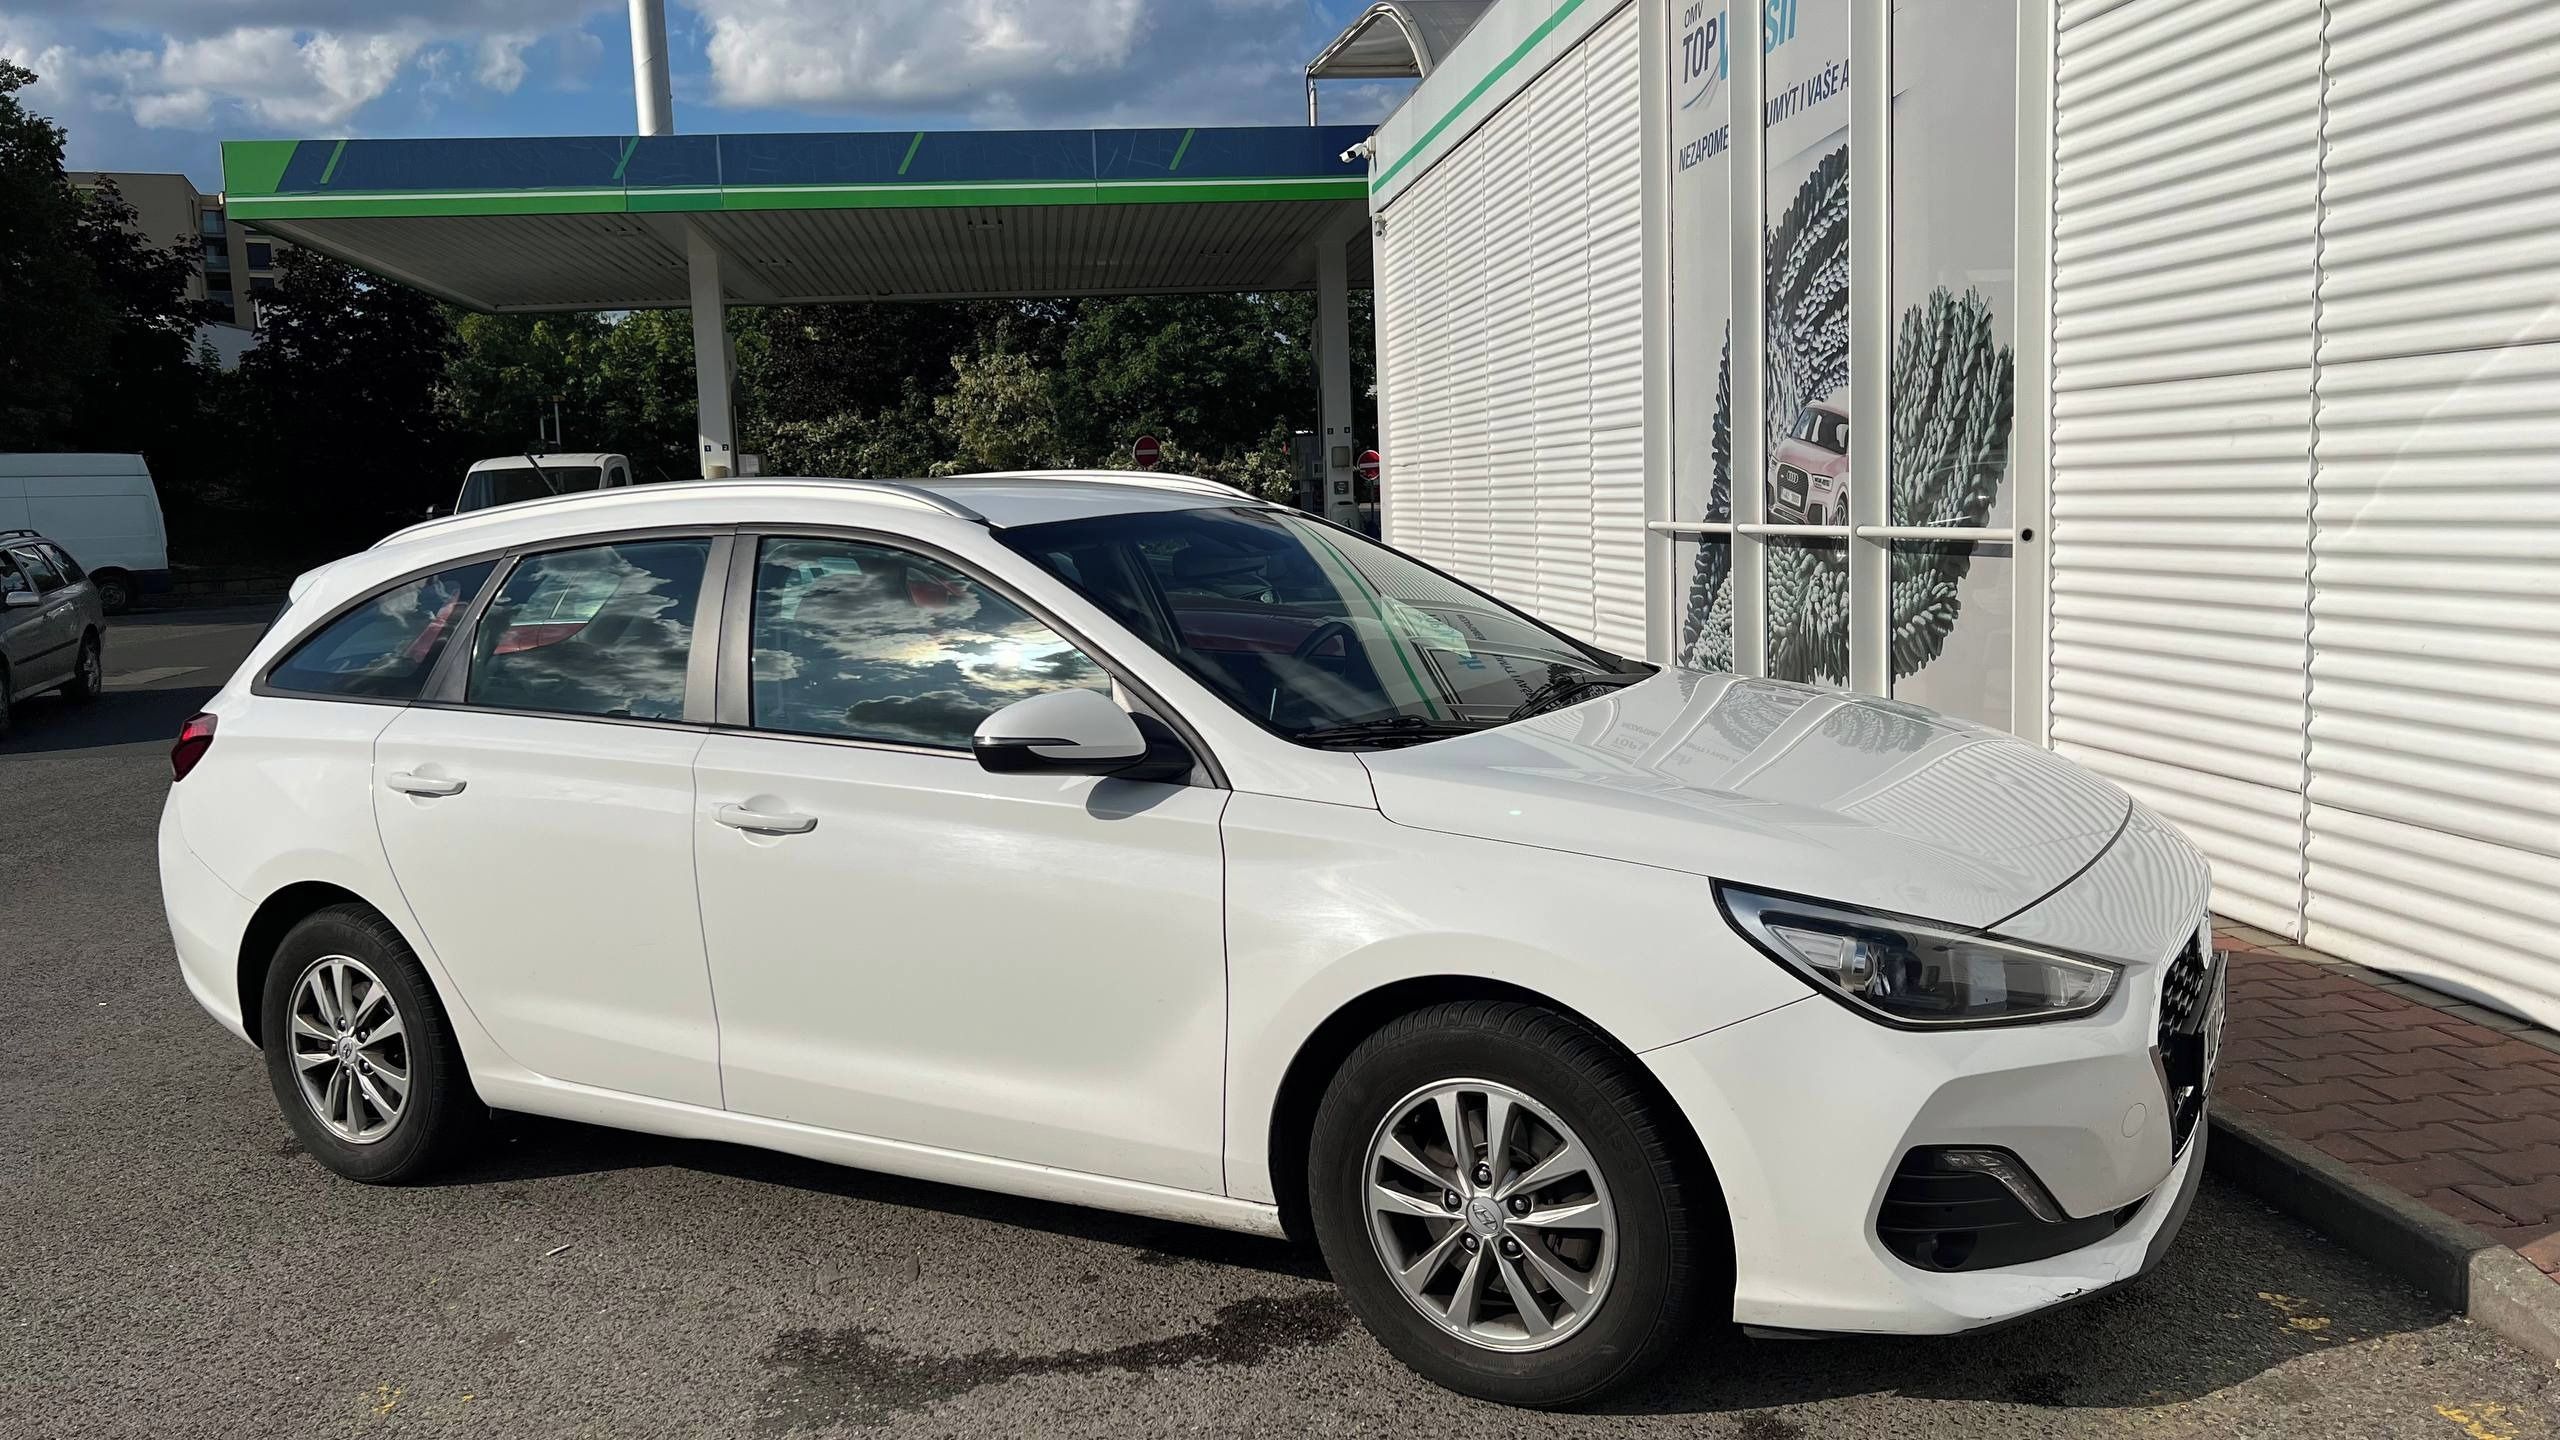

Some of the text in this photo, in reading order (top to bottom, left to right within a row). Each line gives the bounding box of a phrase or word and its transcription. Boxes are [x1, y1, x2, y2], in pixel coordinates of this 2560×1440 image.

[1685, 1, 1703, 28] OMV
[1679, 124, 1728, 173] NEZAPOME
[1800, 83, 1805, 112] I
[1808, 60, 1840, 107] VAŠE
